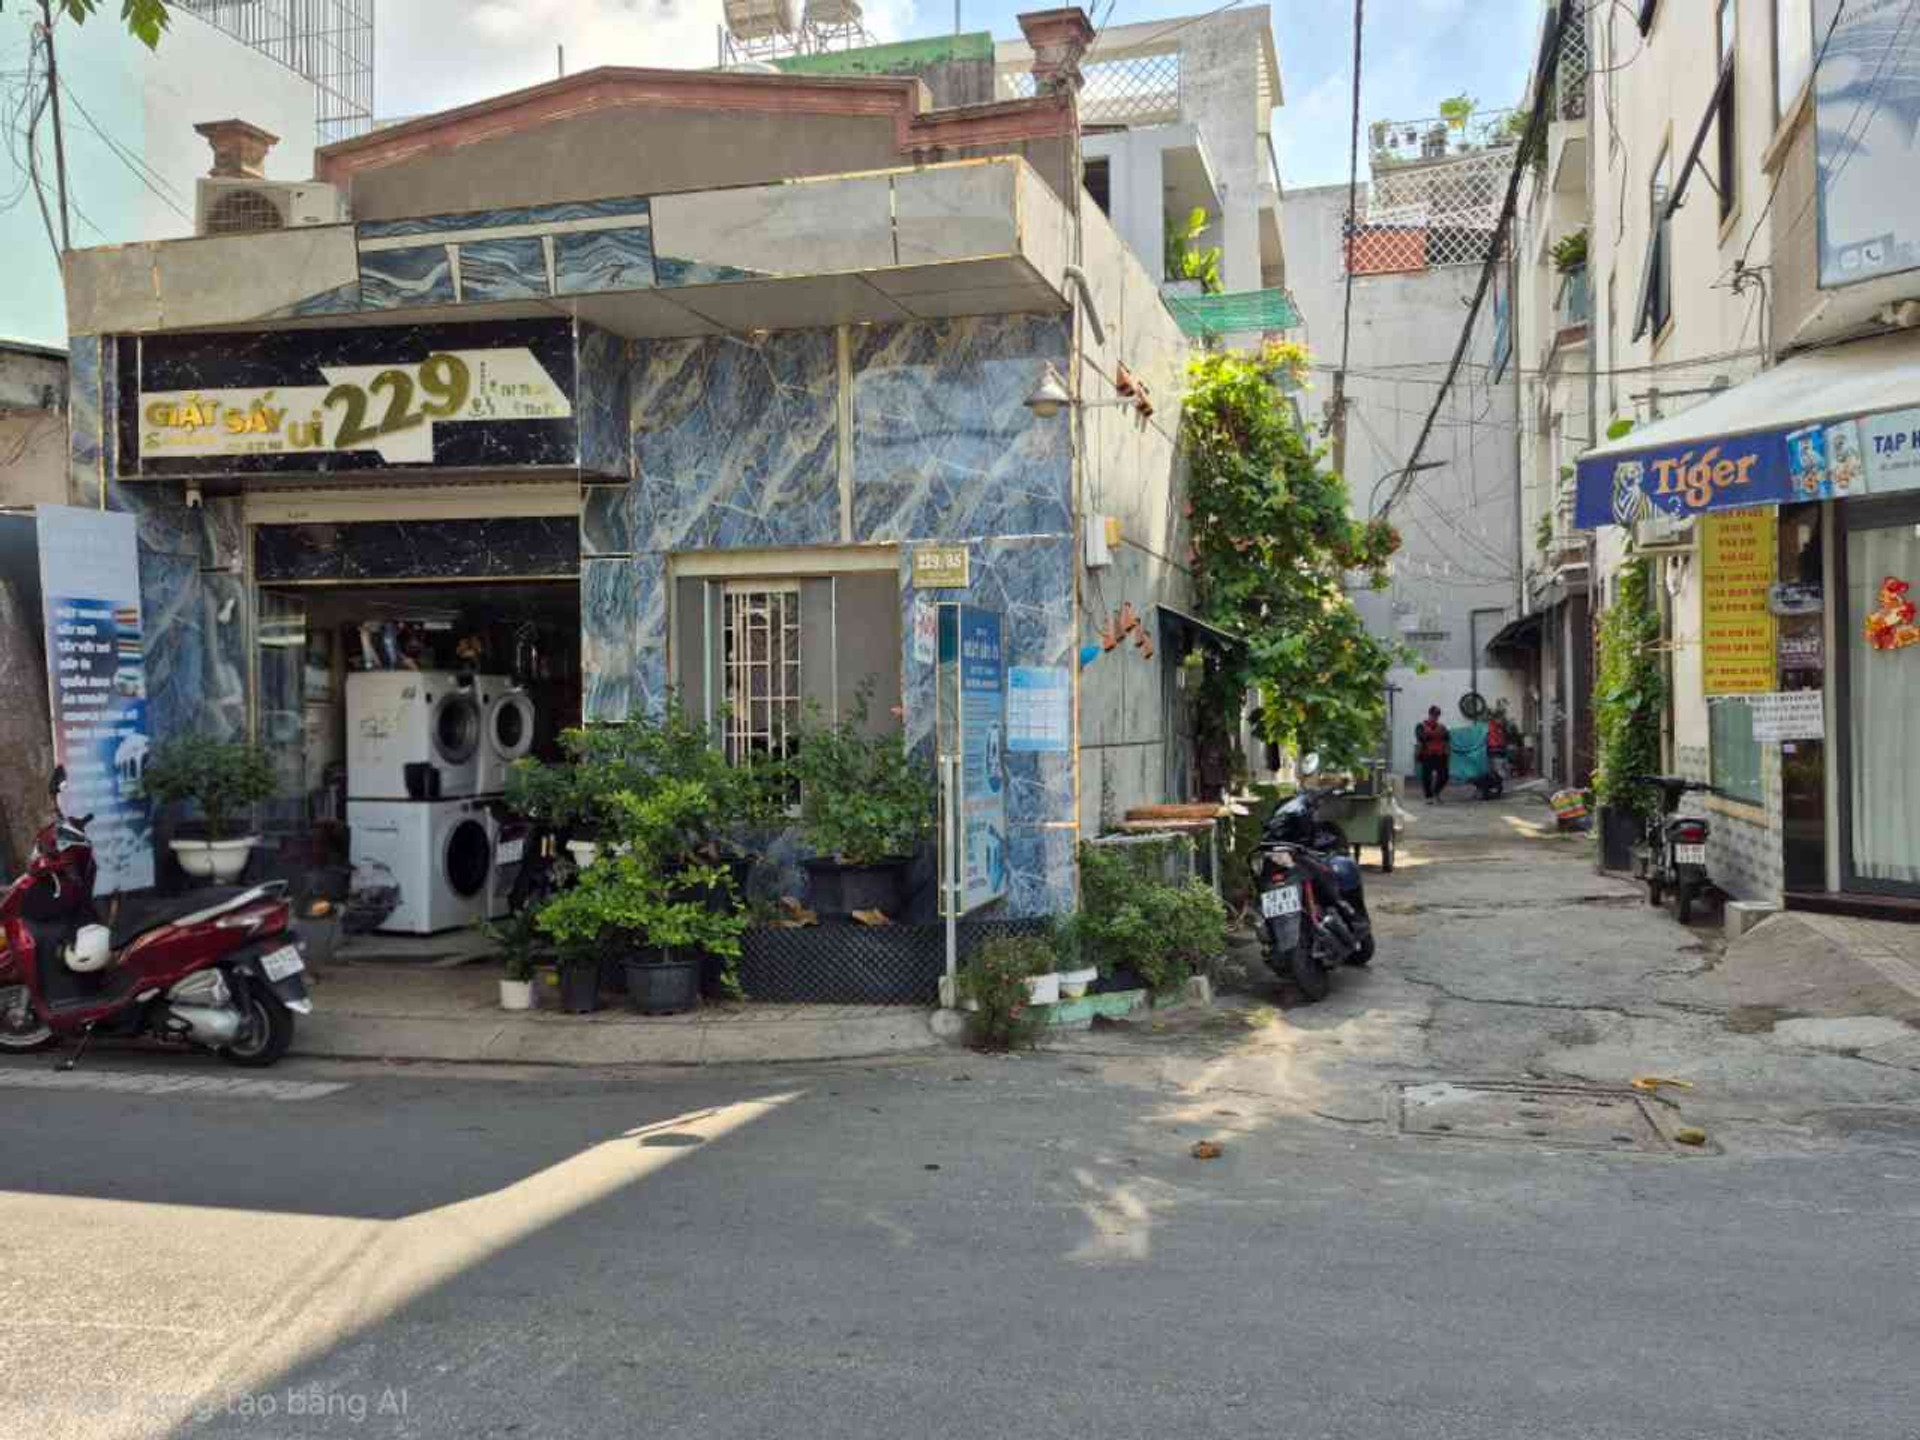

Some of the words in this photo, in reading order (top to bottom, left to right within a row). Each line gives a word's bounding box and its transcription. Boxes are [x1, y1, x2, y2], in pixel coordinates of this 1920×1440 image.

[324, 353, 470, 448] 229
[1872, 432, 1908, 459] TẠP
[1652, 446, 1758, 508] Tiger
